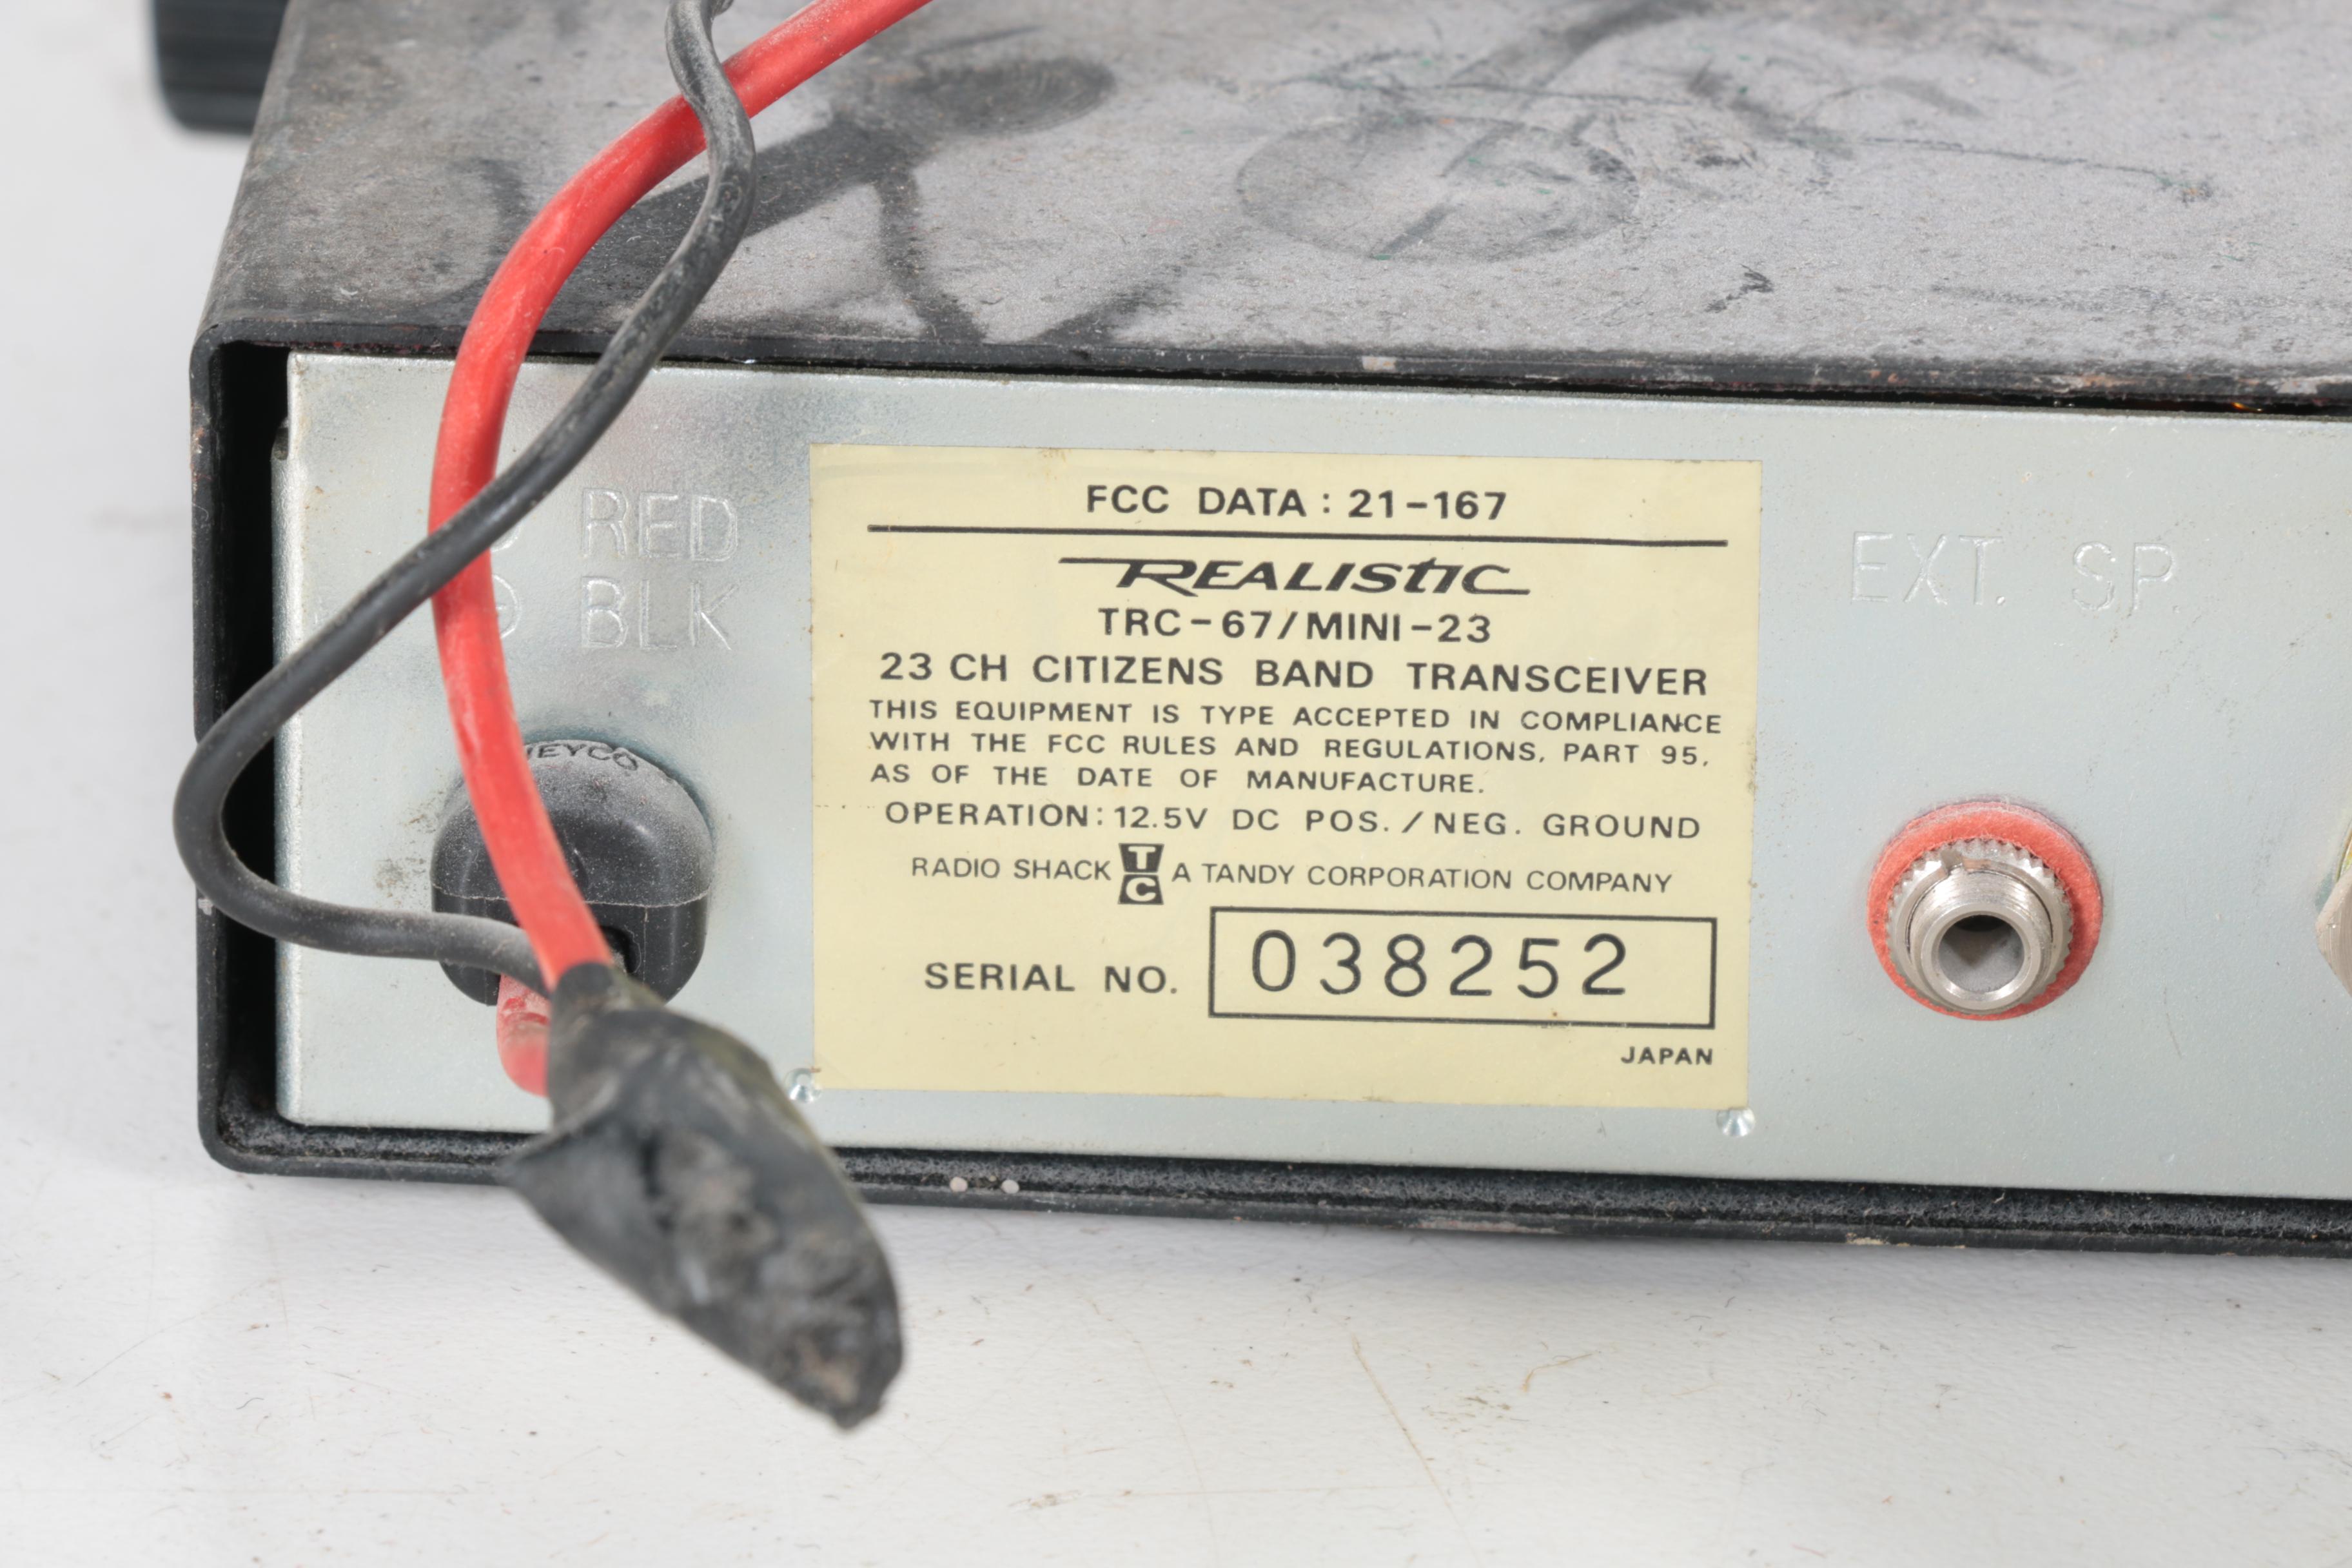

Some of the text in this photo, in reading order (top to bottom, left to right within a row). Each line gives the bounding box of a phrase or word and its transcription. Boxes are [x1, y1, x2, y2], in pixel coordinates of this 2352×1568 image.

[1086, 484, 1170, 514] FCC
[1347, 487, 1507, 521] 21-167
[580, 487, 739, 562] RED
[1850, 530, 2006, 606] EXT.
[580, 575, 739, 651] BLK
[879, 651, 1708, 697] 23 CH CITIZENS BAND TRANSCEIVER
[868, 698, 1722, 735] THIS EQUIPMENT IS TYPE ACCEPTED IN COMPLIANCE
[869, 730, 950, 752] WITH
[970, 732, 1027, 754] THE
[1047, 733, 1106, 755] FCC
[1122, 734, 1217, 756] RULES
[1233, 736, 1300, 758] AND
[1563, 741, 1640, 765] PART
[869, 762, 1485, 794] AS OF THE DATE OF MANUFACTURE.
[1231, 807, 1280, 832] DC
[1542, 812, 1701, 839] GROUND
[911, 856, 1112, 882] RADIO SHACK
[1171, 861, 1673, 894] A TANDY CORPORATION COMPANY
[924, 928, 1627, 1000] SERIAL NO. 038252
[1620, 1045, 1714, 1066] JAPAN
